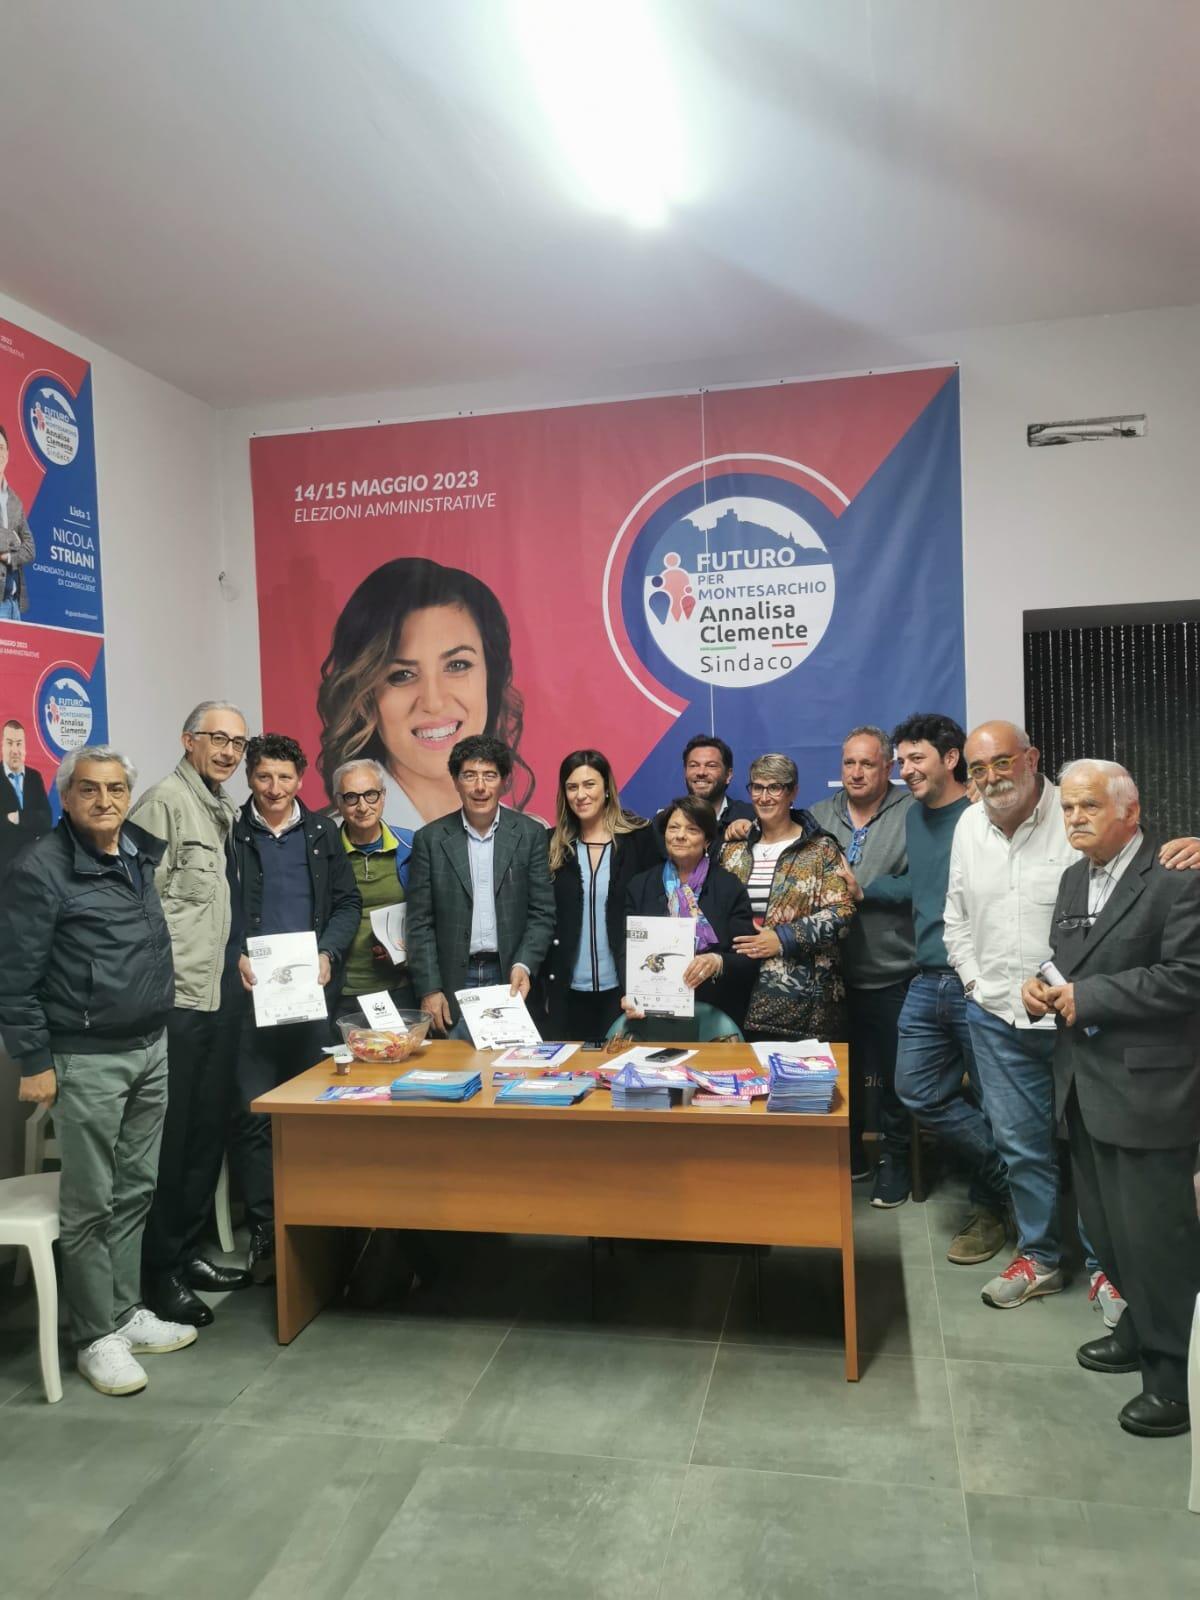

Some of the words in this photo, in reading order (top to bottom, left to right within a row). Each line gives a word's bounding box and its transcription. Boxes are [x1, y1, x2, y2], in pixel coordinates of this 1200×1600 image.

[44, 406, 70, 422] FUTURO
[46, 428, 71, 443] Annalisa
[46, 436, 73, 452] Clemente
[294, 481, 346, 501] 14/15
[352, 474, 428, 497] MAGGIO
[432, 470, 479, 491] 2023
[70, 506, 85, 519] Lista
[86, 511, 91, 521] 1
[294, 505, 361, 523] ELEZIONI
[365, 493, 497, 518] AMMINISTRATIVE
[53, 527, 95, 552] NICOLA
[50, 545, 95, 569] STRIANI
[697, 547, 796, 572] FUTURO
[32, 563, 65, 577] CANDIDATO
[65, 570, 78, 580] ALLA
[78, 573, 96, 584] CARICA
[698, 573, 725, 586] PER
[57, 578, 64, 586] DI
[64, 579, 96, 593] CONSIGLIERE
[698, 581, 827, 601] MONTESARCHIO
[700, 601, 796, 624] Annalisa
[700, 622, 808, 644] Clemente
[701, 652, 792, 673] Sindaco
[59, 697, 84, 707] FUTURO
[60, 719, 84, 727] Annalisa
[61, 727, 87, 735] Clemente
